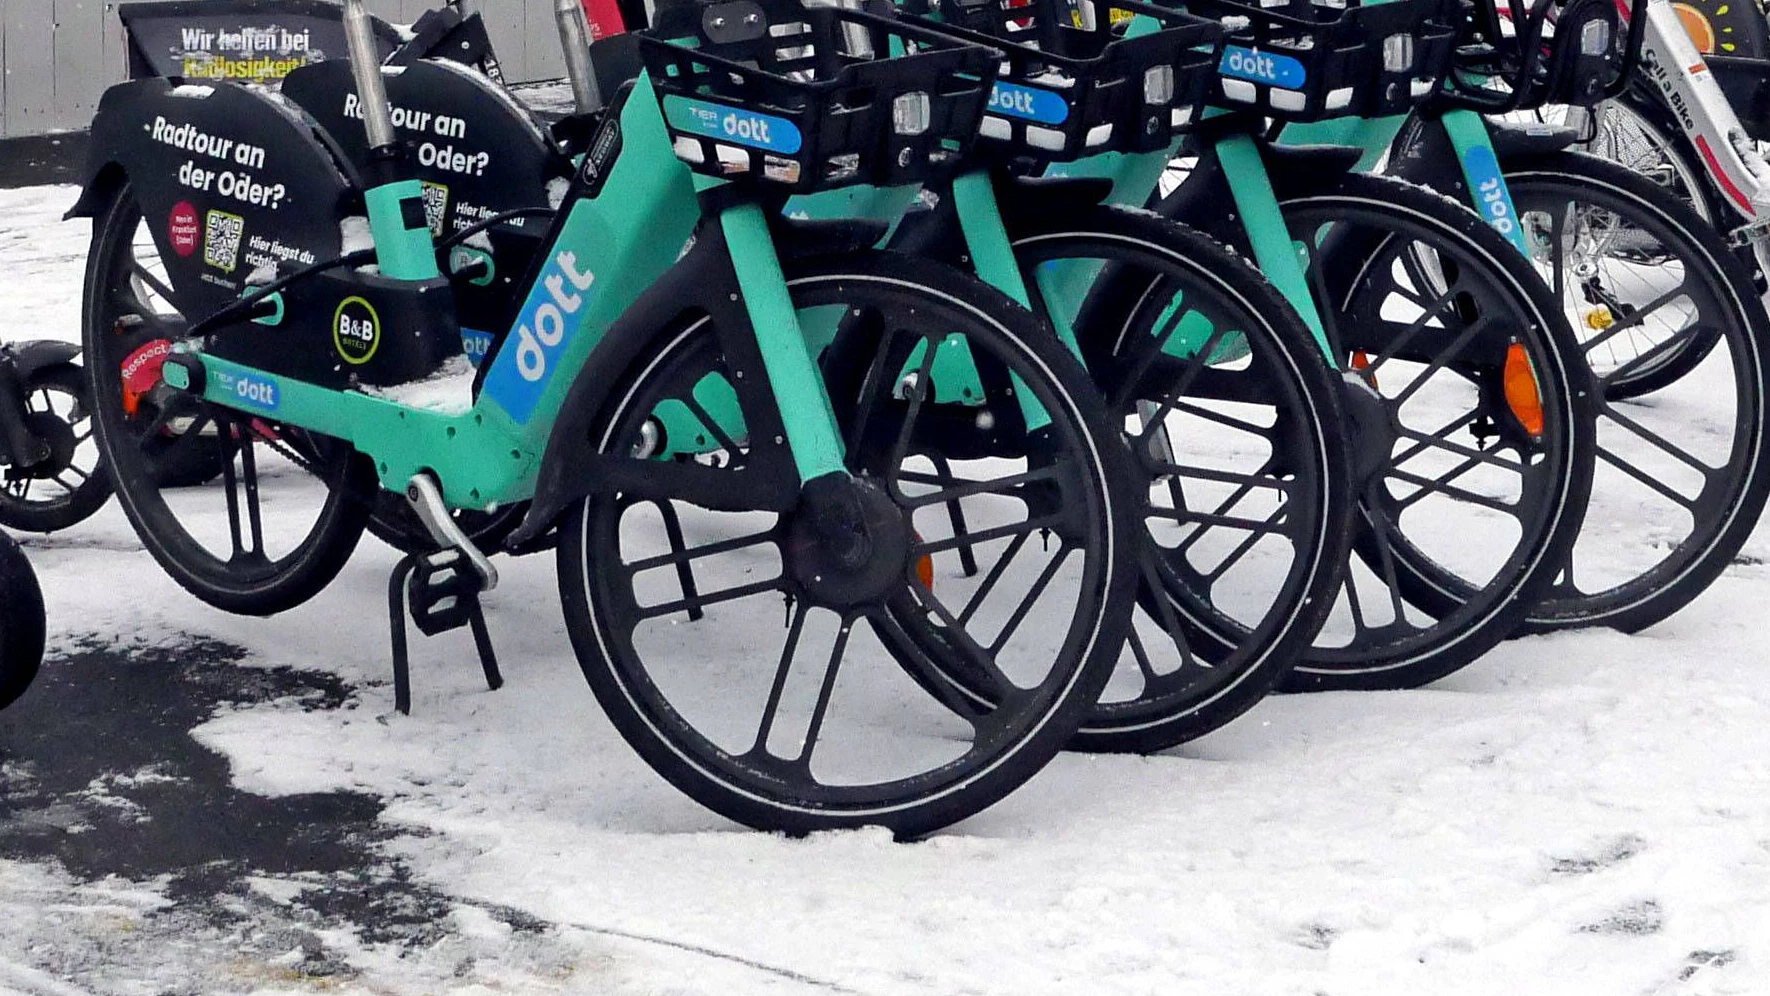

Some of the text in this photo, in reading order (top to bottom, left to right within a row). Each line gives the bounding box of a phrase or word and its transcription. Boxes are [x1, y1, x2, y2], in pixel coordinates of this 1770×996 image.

[181, 26, 309, 51] Wir helfen bei
[1230, 52, 1275, 78] dott
[343, 93, 466, 139] Ratour an
[1669, 89, 1694, 130] Bike
[152, 116, 266, 169] Radtour an
[723, 113, 771, 144] dott
[418, 142, 490, 176] Oder?
[178, 160, 286, 209] der Oder?
[456, 202, 478, 216] Hier
[1480, 177, 1513, 234] dott
[249, 235, 315, 265] Hier liegst du
[338, 313, 374, 341] B&B
[516, 250, 595, 382] dott
[463, 335, 491, 355] ott
[122, 344, 169, 379] Respect
[236, 377, 275, 406] dott
